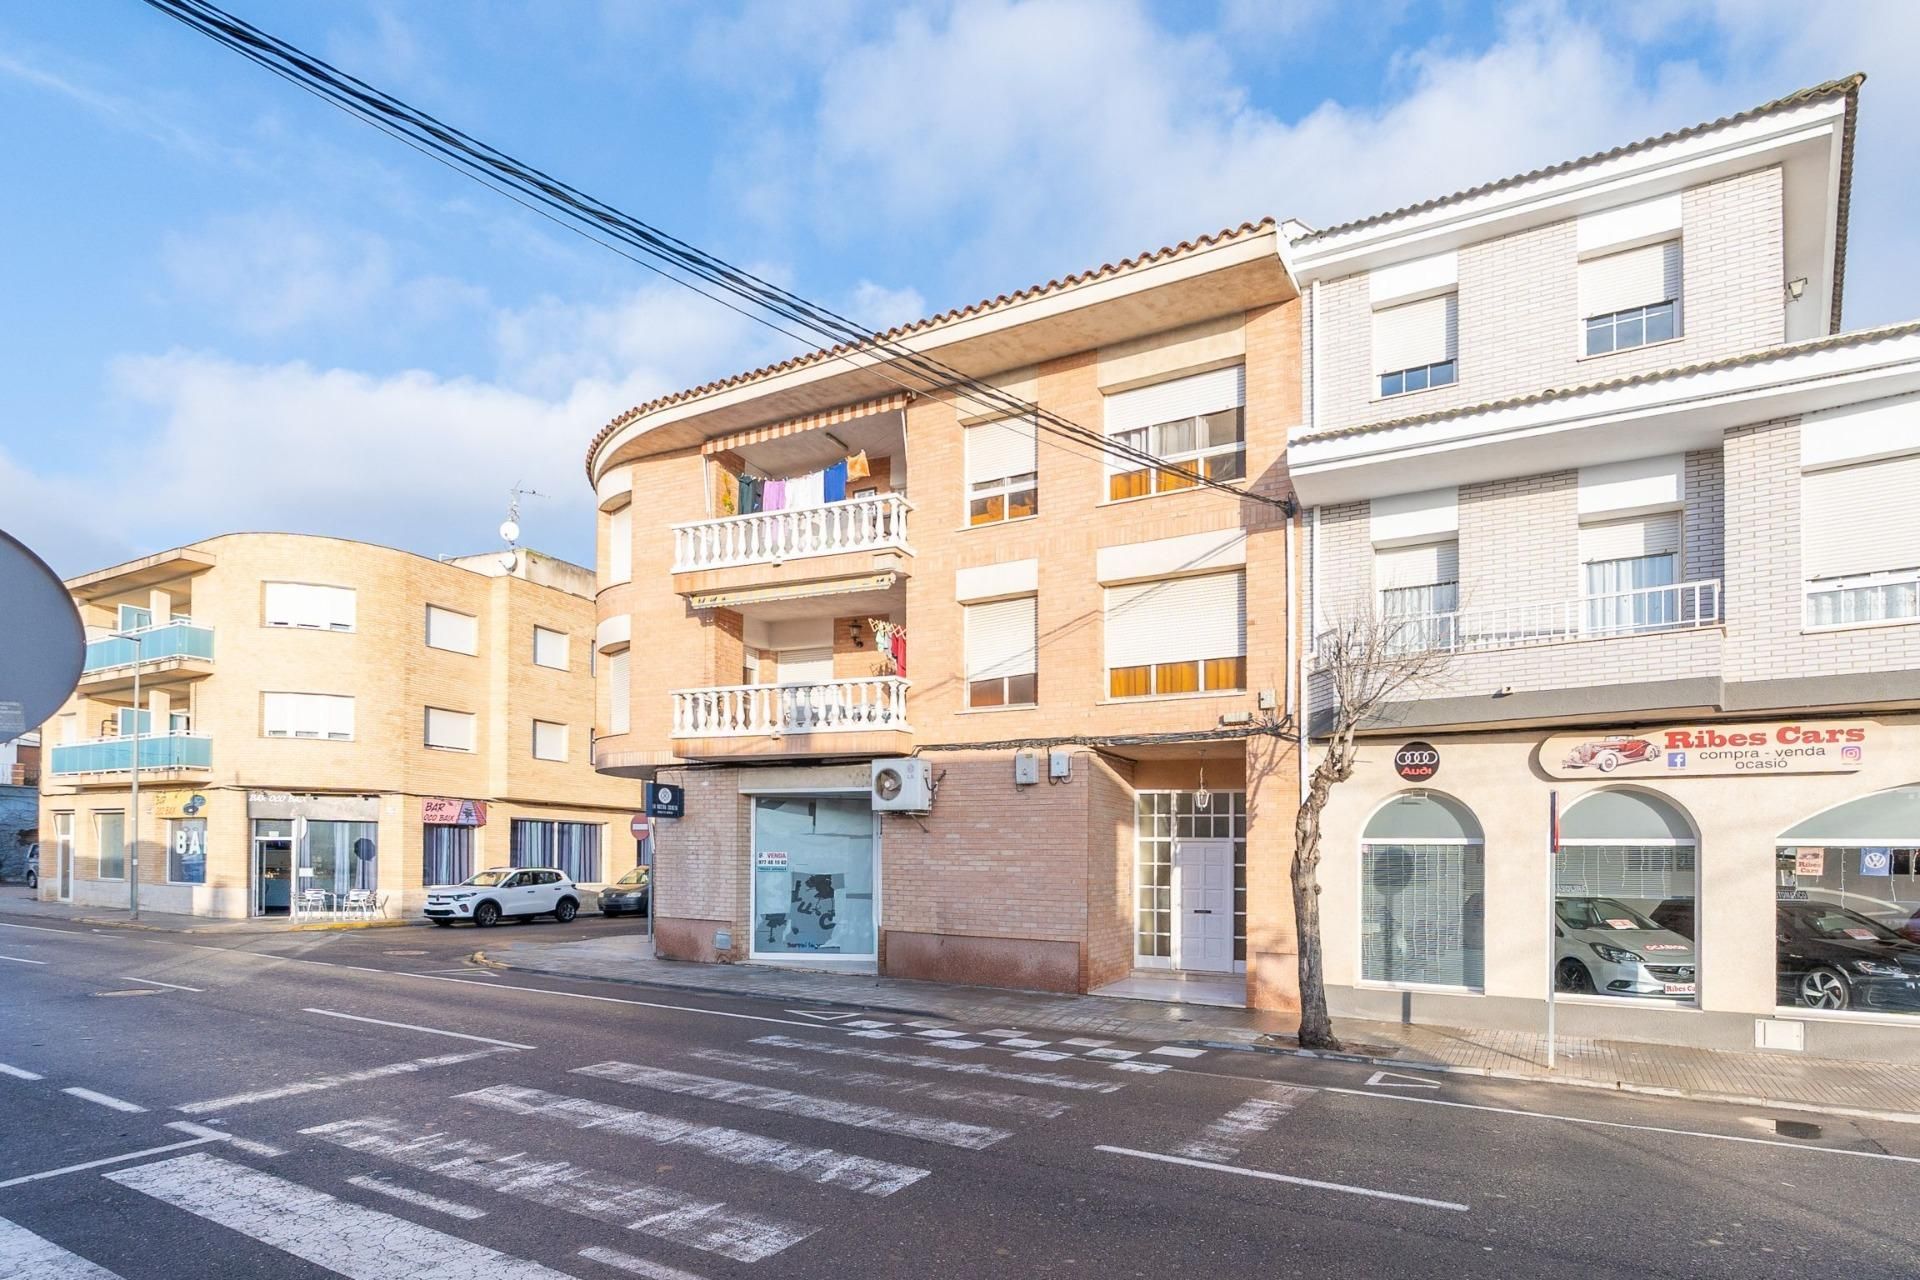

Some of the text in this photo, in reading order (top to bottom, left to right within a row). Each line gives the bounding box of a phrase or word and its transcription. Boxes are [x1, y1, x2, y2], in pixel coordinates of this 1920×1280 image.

[1664, 726, 1866, 749] Ribes Cars
[1699, 750, 1760, 760] compra
[1775, 746, 1827, 758] venda
[1735, 758, 1788, 769] ocasió
[1401, 767, 1432, 775] Audi
[425, 802, 446, 812] BAR
